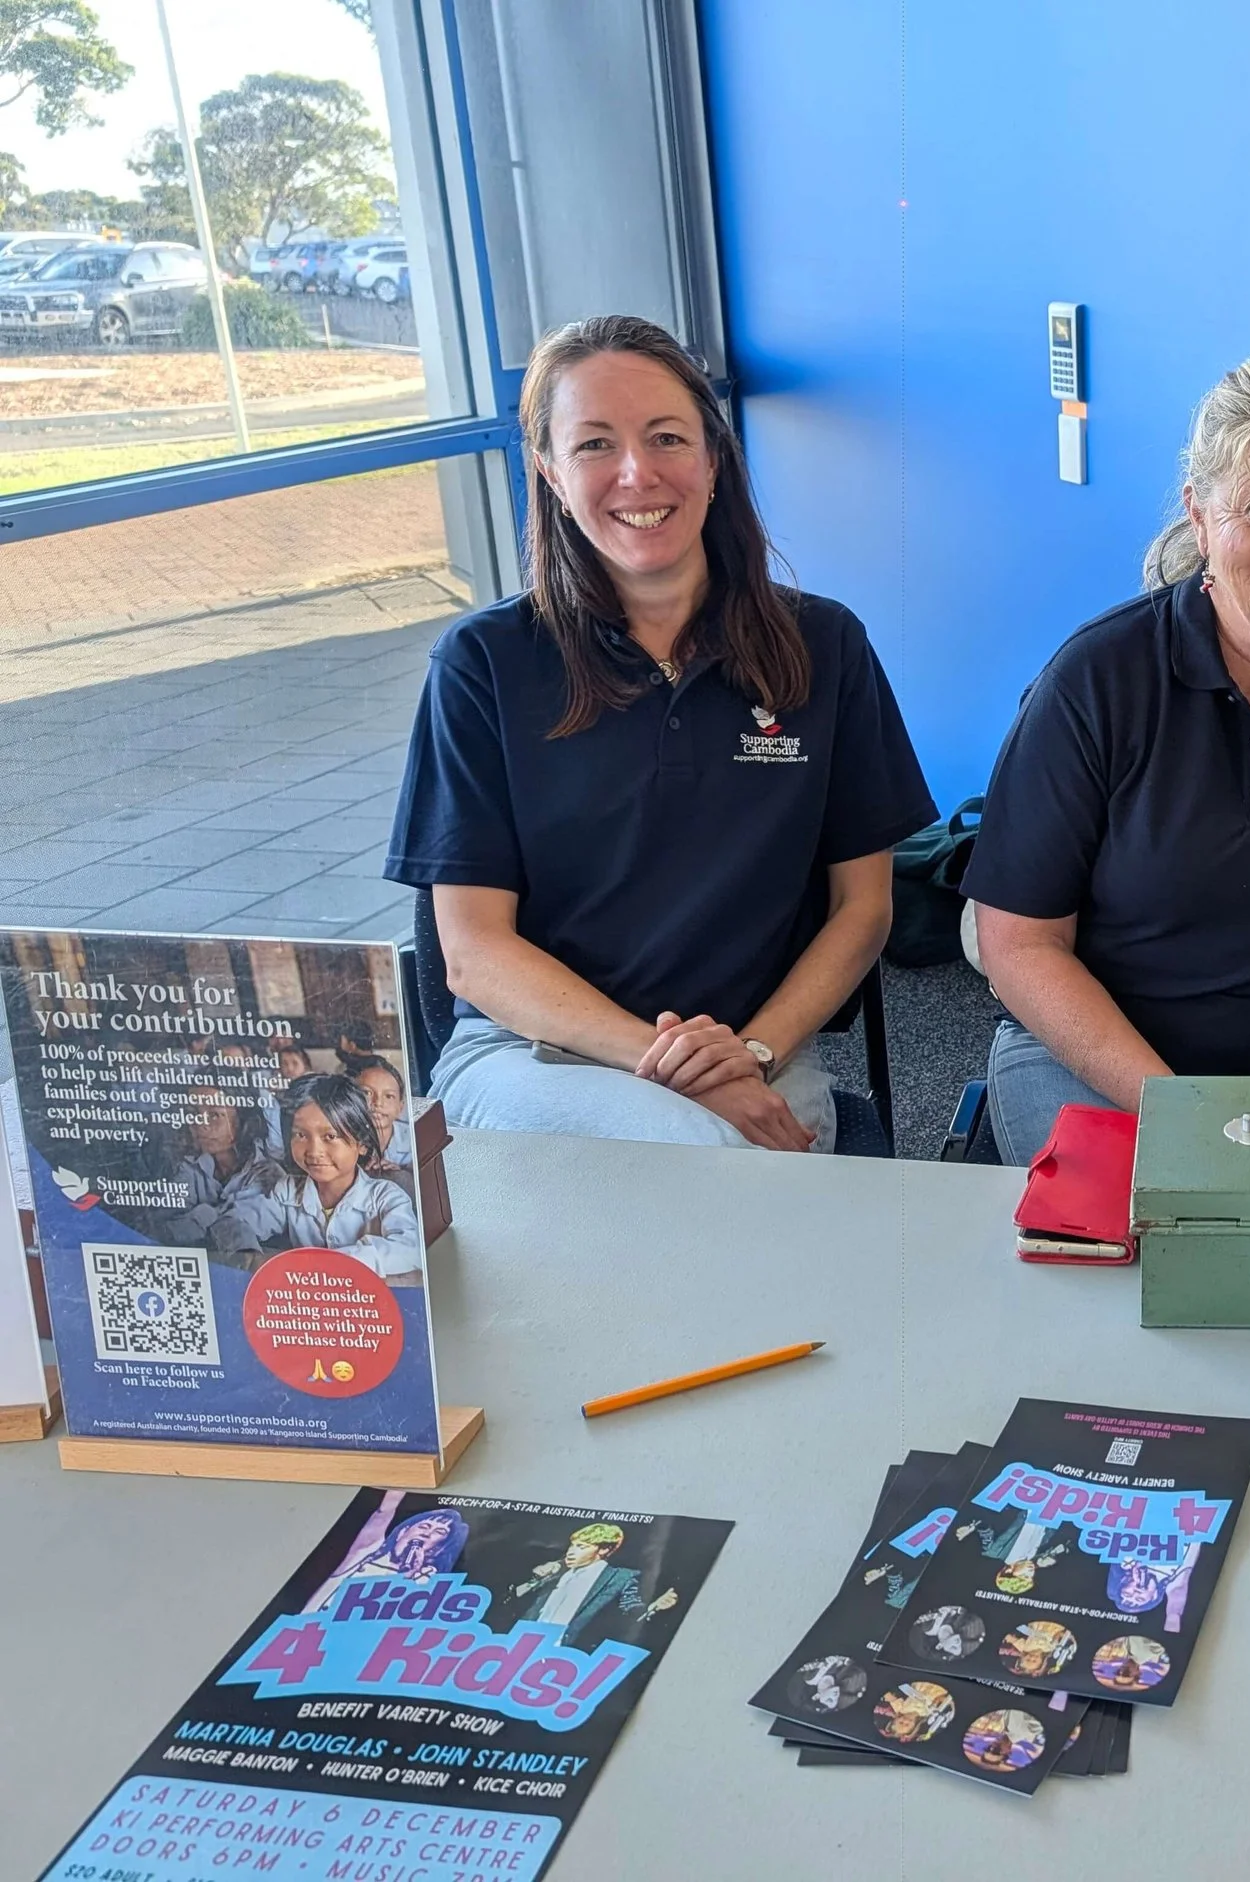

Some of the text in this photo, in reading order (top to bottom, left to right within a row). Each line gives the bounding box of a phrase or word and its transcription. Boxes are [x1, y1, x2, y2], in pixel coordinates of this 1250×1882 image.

[740, 733, 800, 747] Supporting
[743, 743, 799, 755] Cambodia
[30, 970, 236, 1011] Thank you for
[35, 1007, 301, 1039] your contribution.
[39, 1044, 280, 1069] 100% of proceeds are donated
[41, 1063, 291, 1089] to help us lift children and their
[44, 1083, 276, 1109] families out of generations of
[47, 1103, 210, 1129] exploitation, neglect
[50, 1123, 149, 1147] and poverty.
[97, 1175, 188, 1197] Supporting
[103, 1190, 187, 1209] Cambodia
[285, 1271, 353, 1287] We'd love
[266, 1289, 375, 1304] you to consider
[266, 1301, 379, 1320] making an extra
[256, 1315, 392, 1337] donation with your
[272, 1332, 379, 1353] purchase today
[94, 1361, 225, 1380] Scan here to follow us
[122, 1375, 201, 1390] on Facebook
[100, 1421, 135, 1430] registered
[137, 1422, 172, 1431] Australian
[173, 1423, 200, 1433] charity,
[200, 1425, 230, 1434] founded
[232, 1426, 239, 1434] in
[305, 1430, 327, 1439] Island
[328, 1432, 369, 1442] Supporting
[154, 1411, 327, 1430] www.supportingcambodia.org
[1052, 1463, 1176, 1488] BENEFIT VARIETY SHOW
[987, 1467, 1148, 1530] Kids!
[602, 1511, 654, 1524] FINALISTS!
[1173, 1497, 1218, 1536] 4
[1085, 1529, 1179, 1562] Kids
[332, 1579, 481, 1623] Kids
[975, 1590, 1014, 1604] FINALISTS!
[247, 1621, 625, 1720] 4 Kids!
[297, 1702, 504, 1737] BENEFIT VARIETY SHOW
[174, 1720, 588, 1777] MARTINA DOUGLAS JOHN STANDLEY
[163, 1745, 567, 1798] MAGGIE BANTON HUNTER O'BRIEN KICE CHOIR
[132, 1784, 542, 1844] SATURDAY 6 DECEMBER
[110, 1809, 525, 1871] KI PERFORMING ARTS CENTRE
[90, 1833, 197, 1862] DOORS
[212, 1847, 281, 1871] 6PM
[326, 1859, 428, 1882] MUSIC
[64, 1863, 96, 1879] $20
